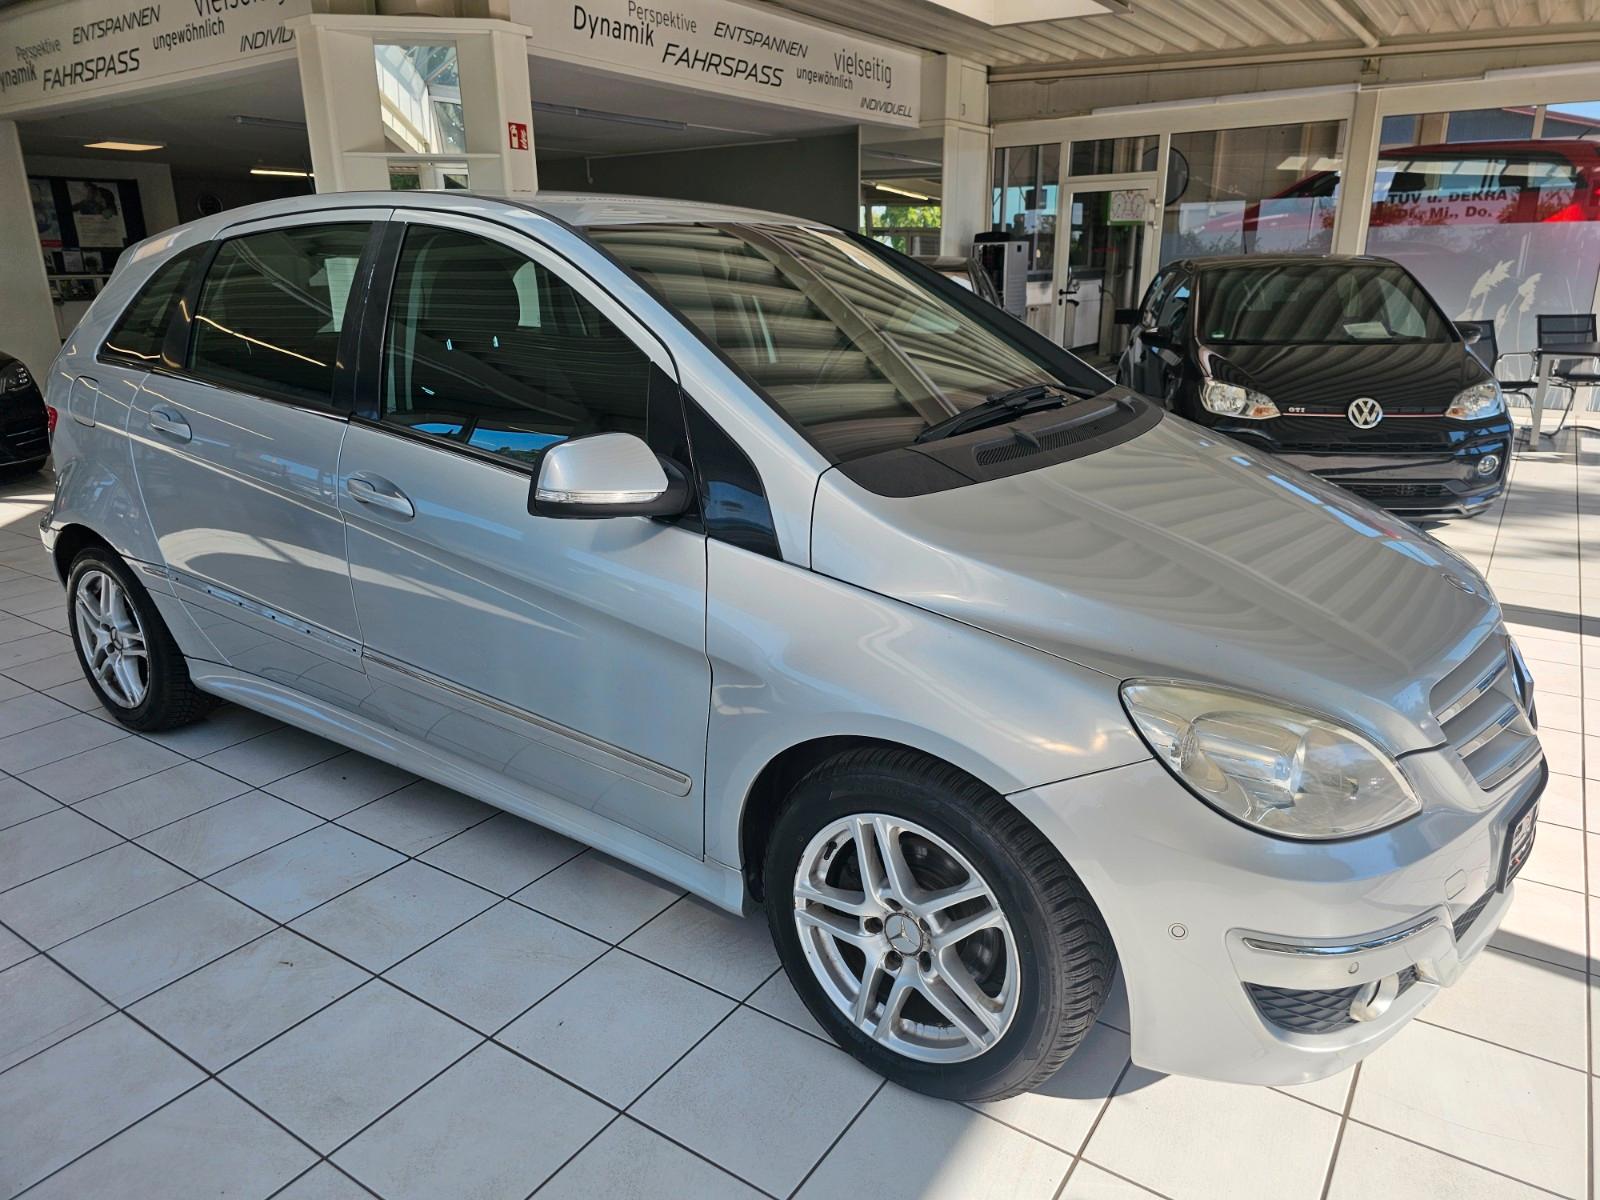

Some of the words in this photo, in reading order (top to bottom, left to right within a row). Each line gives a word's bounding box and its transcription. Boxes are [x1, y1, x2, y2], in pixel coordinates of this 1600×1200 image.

[72, 5, 161, 45] ENTSPANNEN
[152, 16, 225, 50] ungewöhnlich
[573, 5, 654, 47] Dynamik
[628, 0, 697, 34] Perspektive
[240, 26, 297, 53] INDIVID
[713, 21, 808, 58] ENTSPANNEN
[42, 47, 140, 91] FAHRSPASS
[662, 43, 784, 87] FAHRSPASS
[796, 67, 854, 90] ungewöhnlich
[860, 97, 913, 118] INDIVIDUELL
[1448, 190, 1507, 202] DEKRA
[1348, 397, 1383, 429] VW
